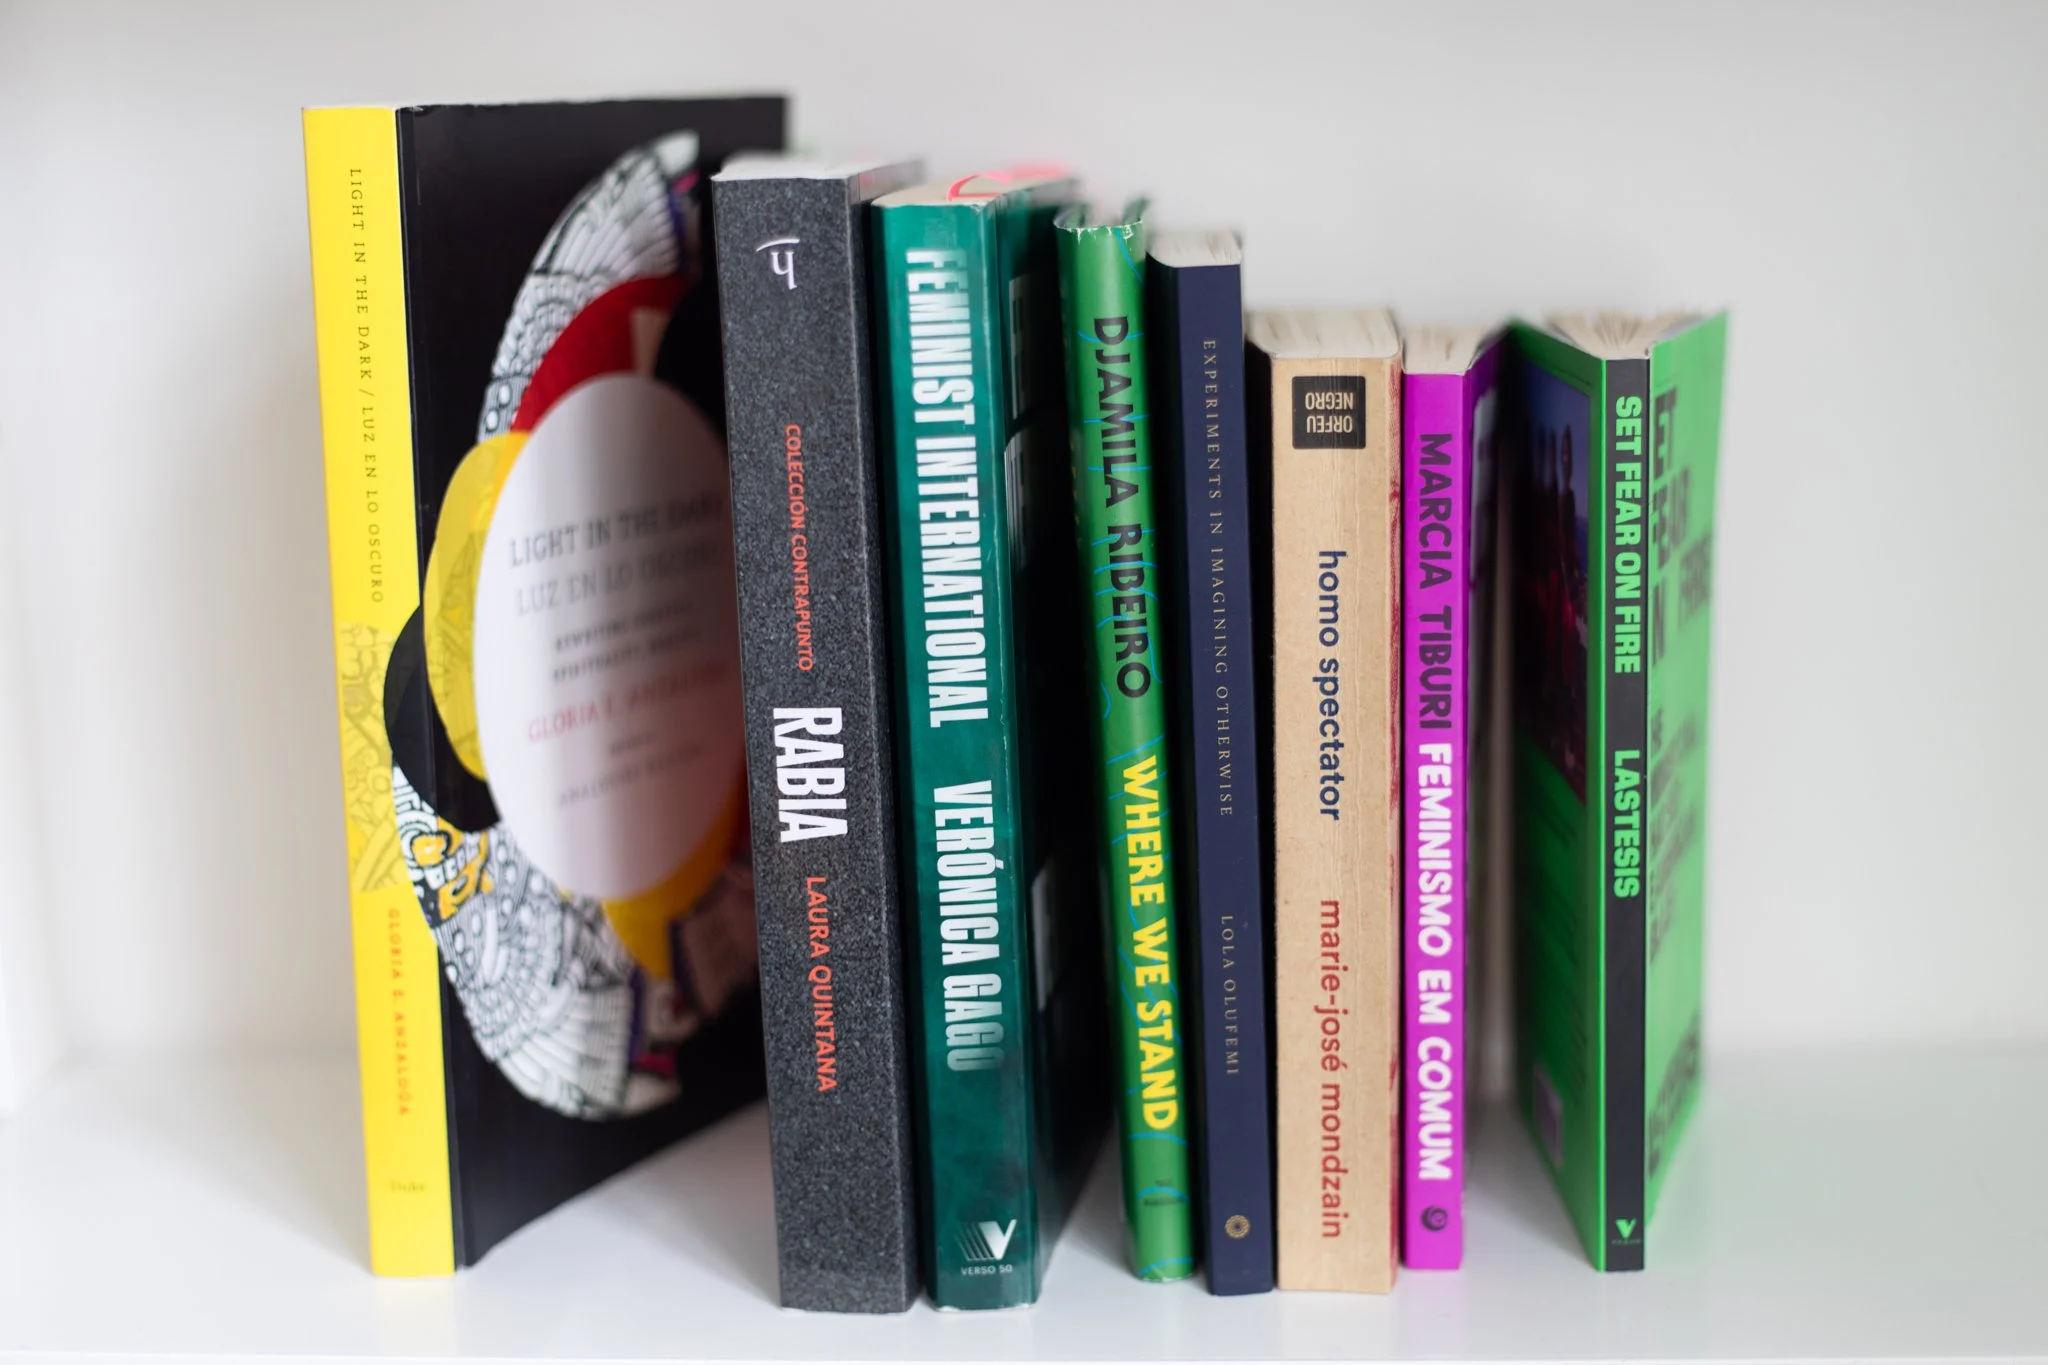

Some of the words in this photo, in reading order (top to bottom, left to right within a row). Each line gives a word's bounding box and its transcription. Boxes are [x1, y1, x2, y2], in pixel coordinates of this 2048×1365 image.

[350, 168, 365, 230] LIGHT
[354, 242, 366, 263] IN
[356, 275, 368, 314] THE
[358, 326, 372, 380] DARK
[905, 248, 975, 426] FEMINIST
[362, 407, 375, 442] LUZ
[1094, 316, 1139, 508] DJAMILA
[1203, 339, 1222, 500] EXPERIMENTS
[1305, 392, 1354, 410] NEGRO
[1306, 415, 1353, 433] ORFEU
[1615, 395, 1642, 456] SET
[365, 454, 376, 478] EN
[366, 490, 378, 513] LO
[786, 424, 809, 528] COLECCIÓN
[1419, 433, 1453, 589] MARCIA
[1615, 462, 1642, 546] FEAR
[368, 523, 383, 603] OSCURO
[510, 523, 579, 568] LIGHT
[586, 515, 611, 550] IN
[1210, 512, 1222, 535] IN
[791, 534, 814, 671] CONTRAPUNTO
[915, 436, 988, 728] INTERNATIONAL
[1107, 523, 1151, 698] RIBEIRO
[1211, 548, 1228, 673] IMAGINING
[1318, 551, 1348, 647] homo
[1614, 551, 1641, 600] ON
[1419, 605, 1452, 729] TIBURI
[1614, 605, 1641, 674] FIRE
[773, 707, 848, 842] RABIA
[1216, 686, 1232, 816] OTHERWISE
[1312, 658, 1345, 821] spectator
[1123, 755, 1166, 908] WHERE
[1418, 743, 1453, 957] FEMINISMO
[1614, 749, 1640, 898] LASTESIS
[805, 876, 830, 959] LAURA
[934, 779, 1004, 966] VERÓNICA
[388, 908, 403, 980] GLORIA
[1133, 917, 1170, 987] WE
[1221, 915, 1235, 969] LOLA
[1315, 900, 1348, 1072] marie-josé
[808, 965, 839, 1092] QUINTANA
[942, 972, 1005, 1072] GAGO
[1223, 979, 1239, 1075] OLUFEMI
[1418, 970, 1453, 1025] EM
[1137, 1000, 1179, 1130] STAND
[1418, 1036, 1453, 1181] COMUM
[1321, 1082, 1348, 1239] mondzain
[961, 1265, 996, 1276] VERSO
